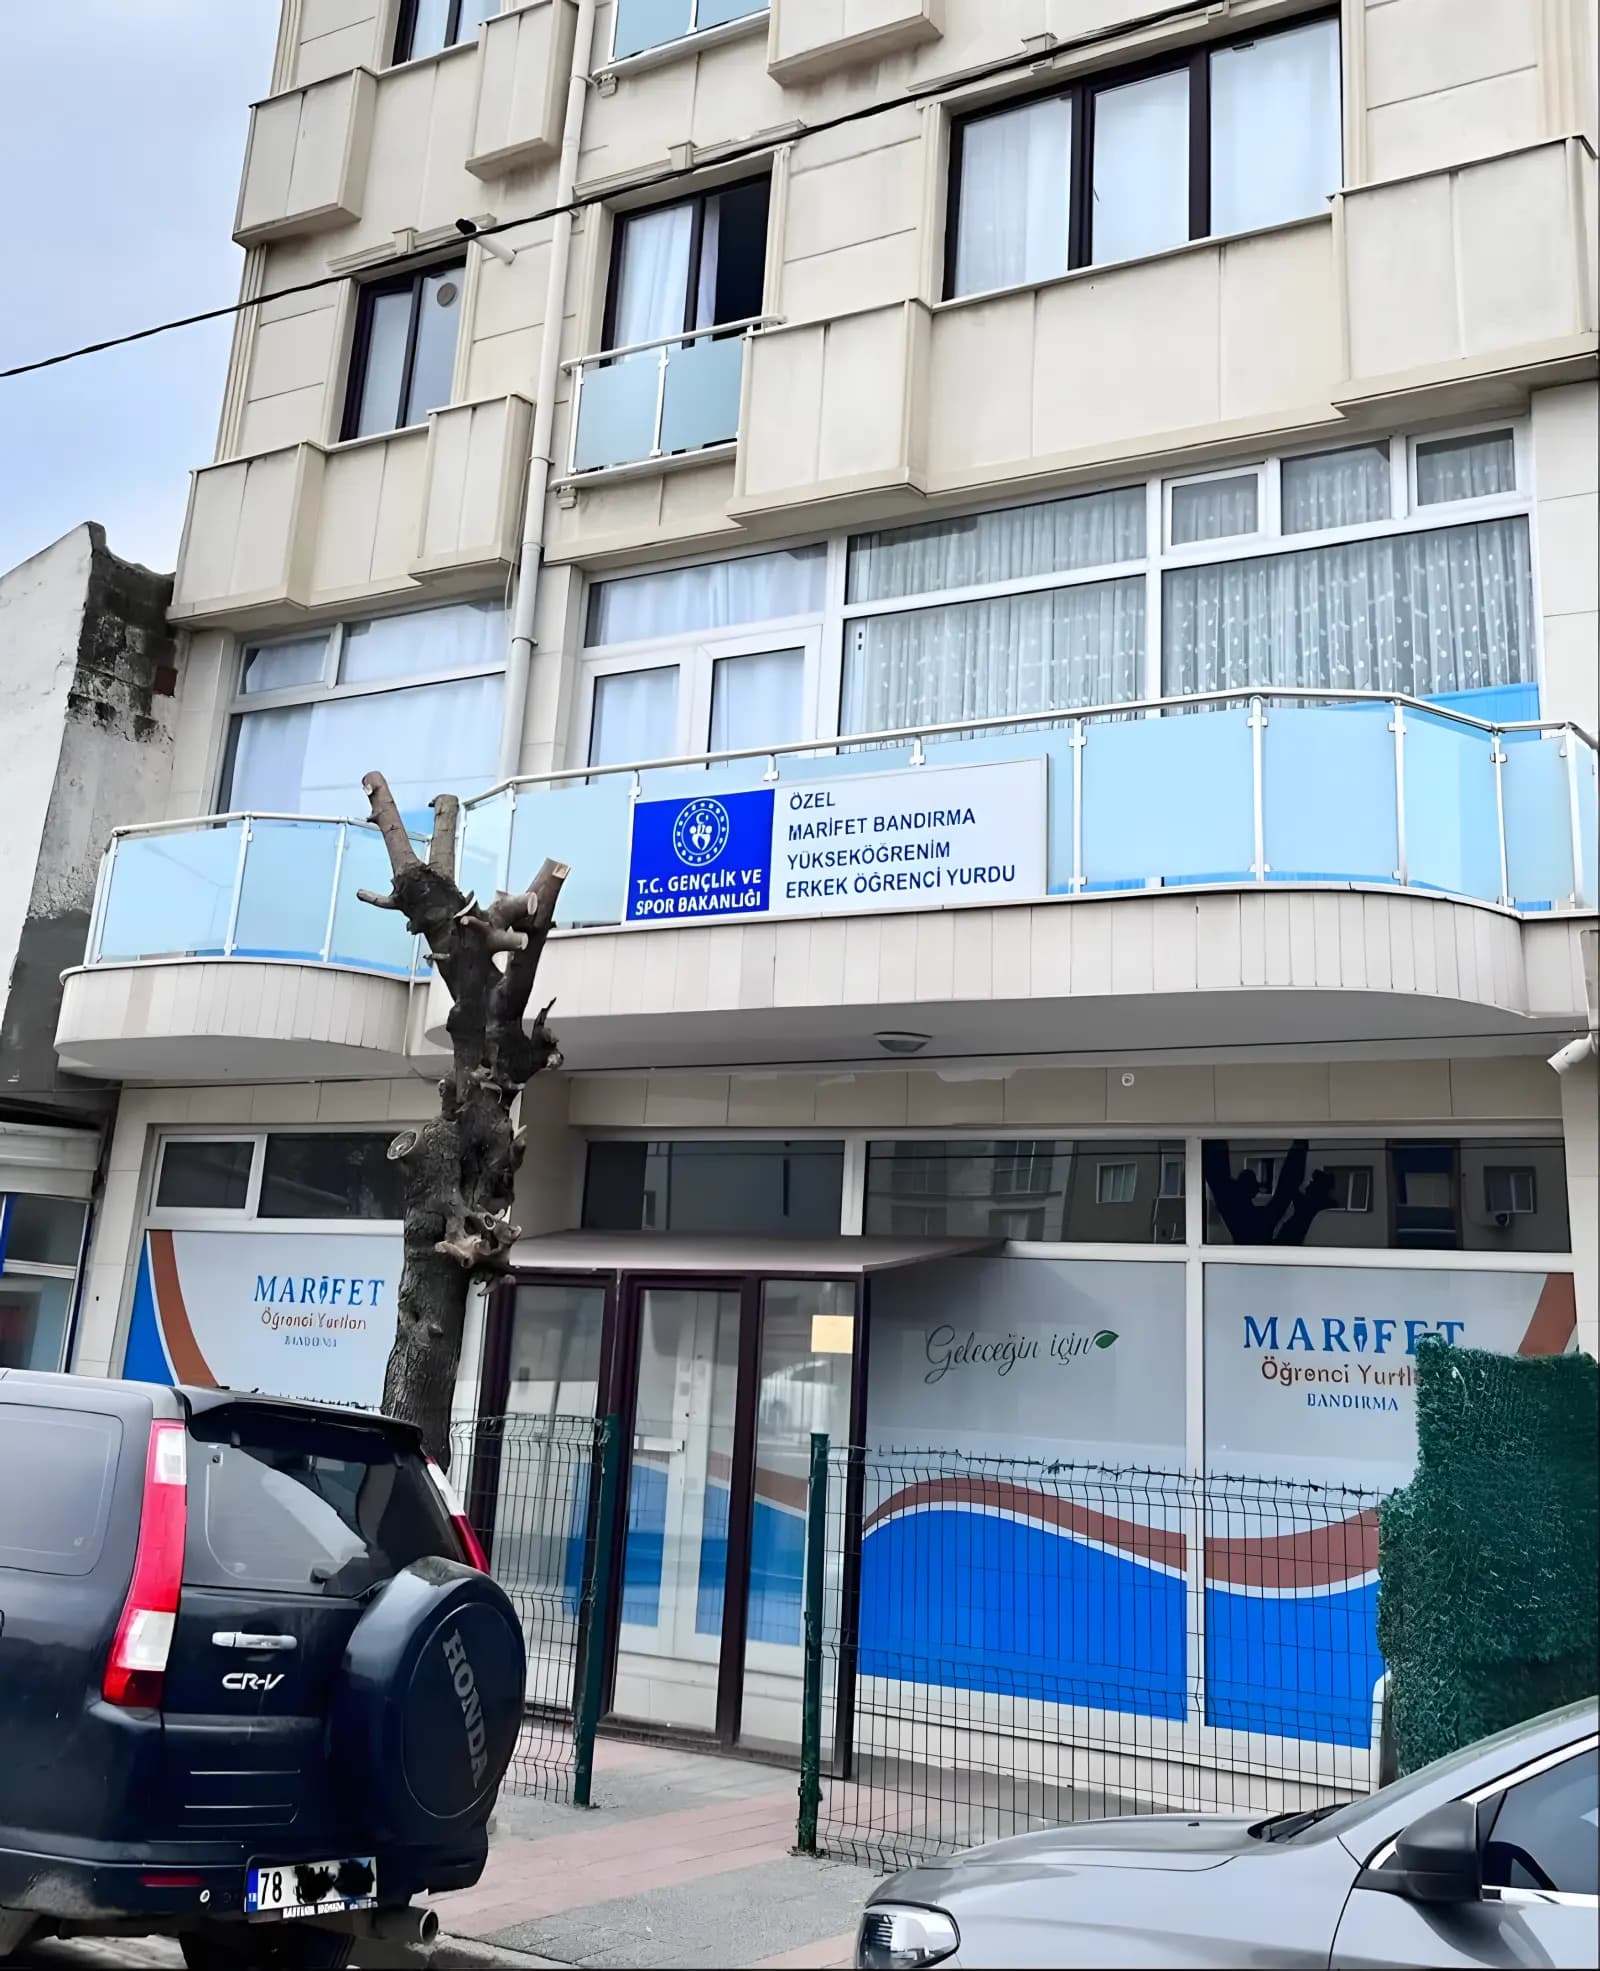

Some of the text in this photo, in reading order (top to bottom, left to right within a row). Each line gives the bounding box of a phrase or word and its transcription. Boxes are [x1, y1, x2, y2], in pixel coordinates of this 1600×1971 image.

[789, 791, 836, 811] ÖZEL
[788, 807, 976, 841] MARİFET BANDIRMA
[786, 838, 951, 871] YÜKSEKÖĞRENİM
[636, 868, 762, 895] T.C. GENÇLİK VE
[785, 864, 1015, 899] ERKEK ÖĞRENCİ YURDU
[634, 888, 761, 916] SPOR BAKANLIĞI
[253, 1274, 385, 1307] MARİFET
[924, 1324, 1094, 1384] Geleceğin için
[1261, 1355, 1420, 1387] Öğrenci Yurtl
[1306, 1392, 1399, 1411] BANDIRMA
[221, 1672, 287, 1691] CR-V
[442, 1628, 489, 1789] HONDA
[260, 1871, 282, 1906] 78
